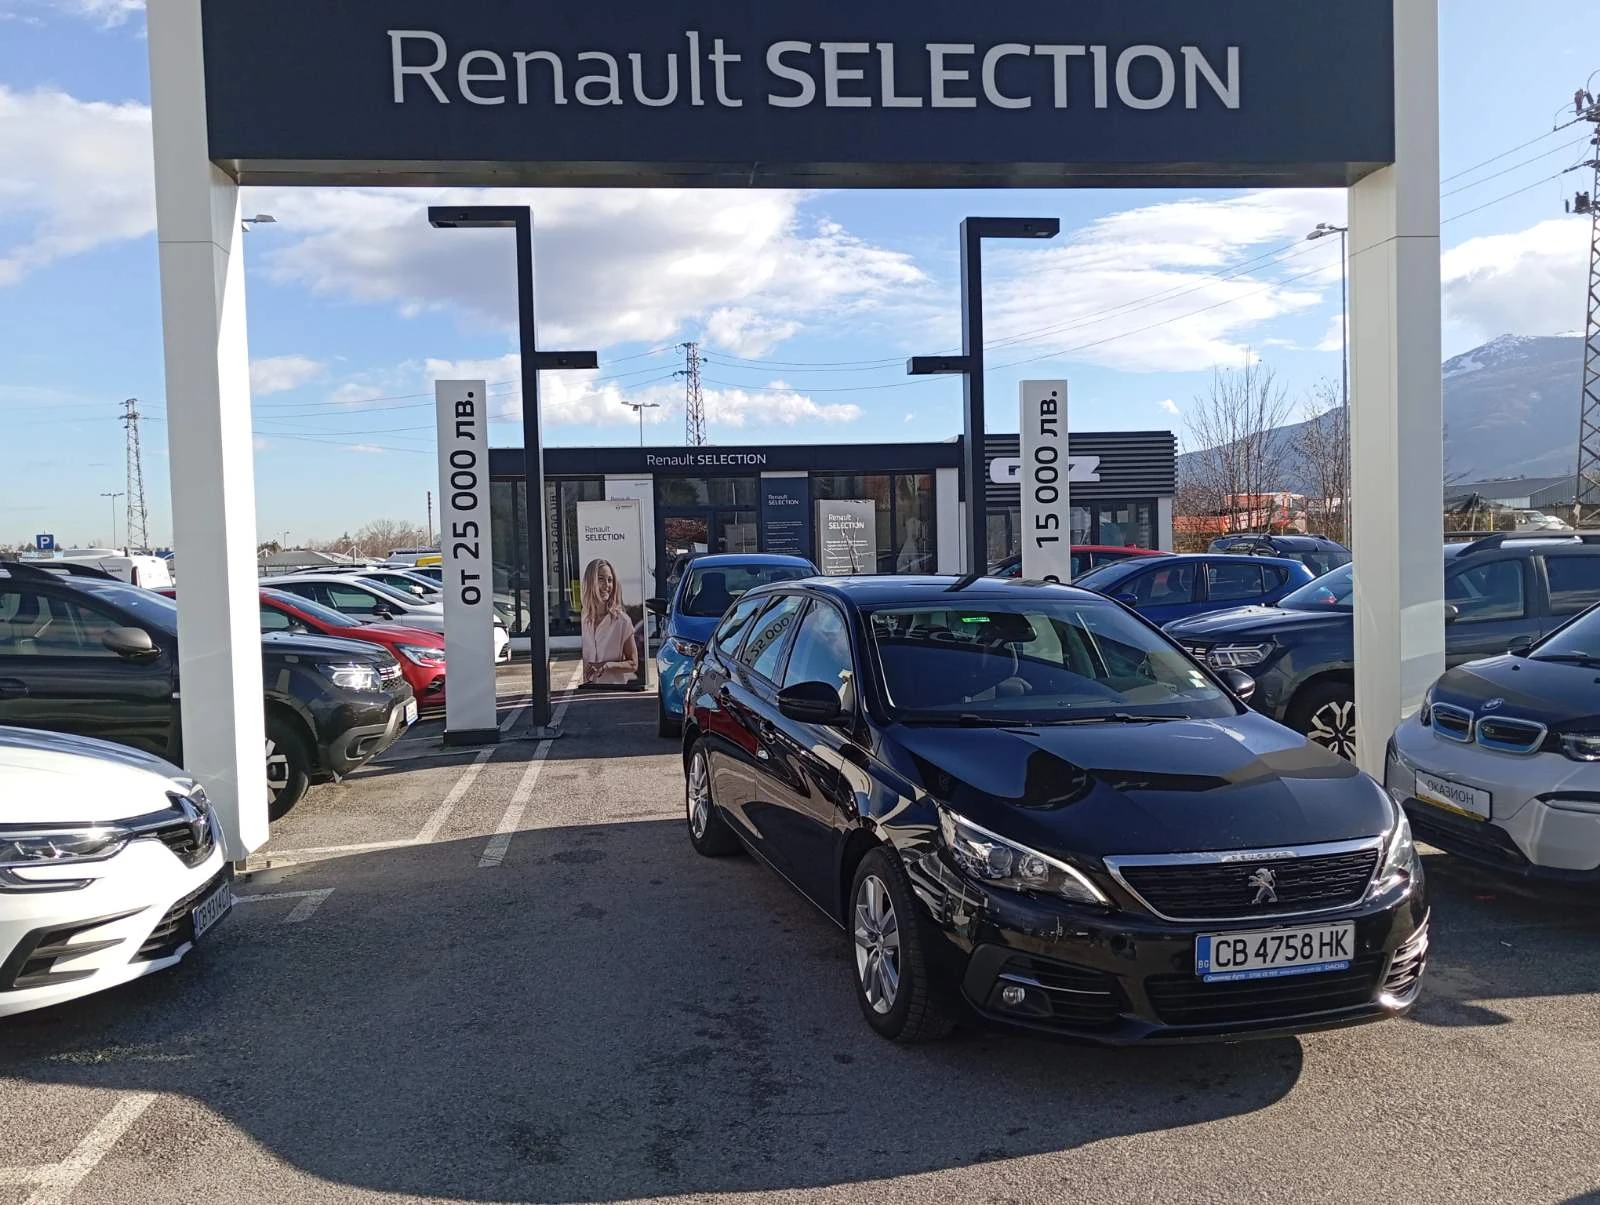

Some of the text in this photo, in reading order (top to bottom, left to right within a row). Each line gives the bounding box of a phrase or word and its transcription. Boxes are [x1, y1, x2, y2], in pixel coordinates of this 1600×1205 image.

[387, 29, 1241, 110] Renault SELECTION
[1040, 390, 1058, 437] лв.
[646, 454, 767, 466] Renault SELECTION
[1034, 446, 1059, 504] 000
[450, 391, 481, 605] от 25 000 лв.
[584, 525, 611, 533] Renault
[828, 513, 852, 521] Renault
[828, 521, 865, 530] SELECTION
[585, 533, 625, 541] SELECTION
[1036, 513, 1059, 549] 15
[1215, 929, 1348, 968] CB 4758 HK
[1198, 960, 1210, 969] BG
